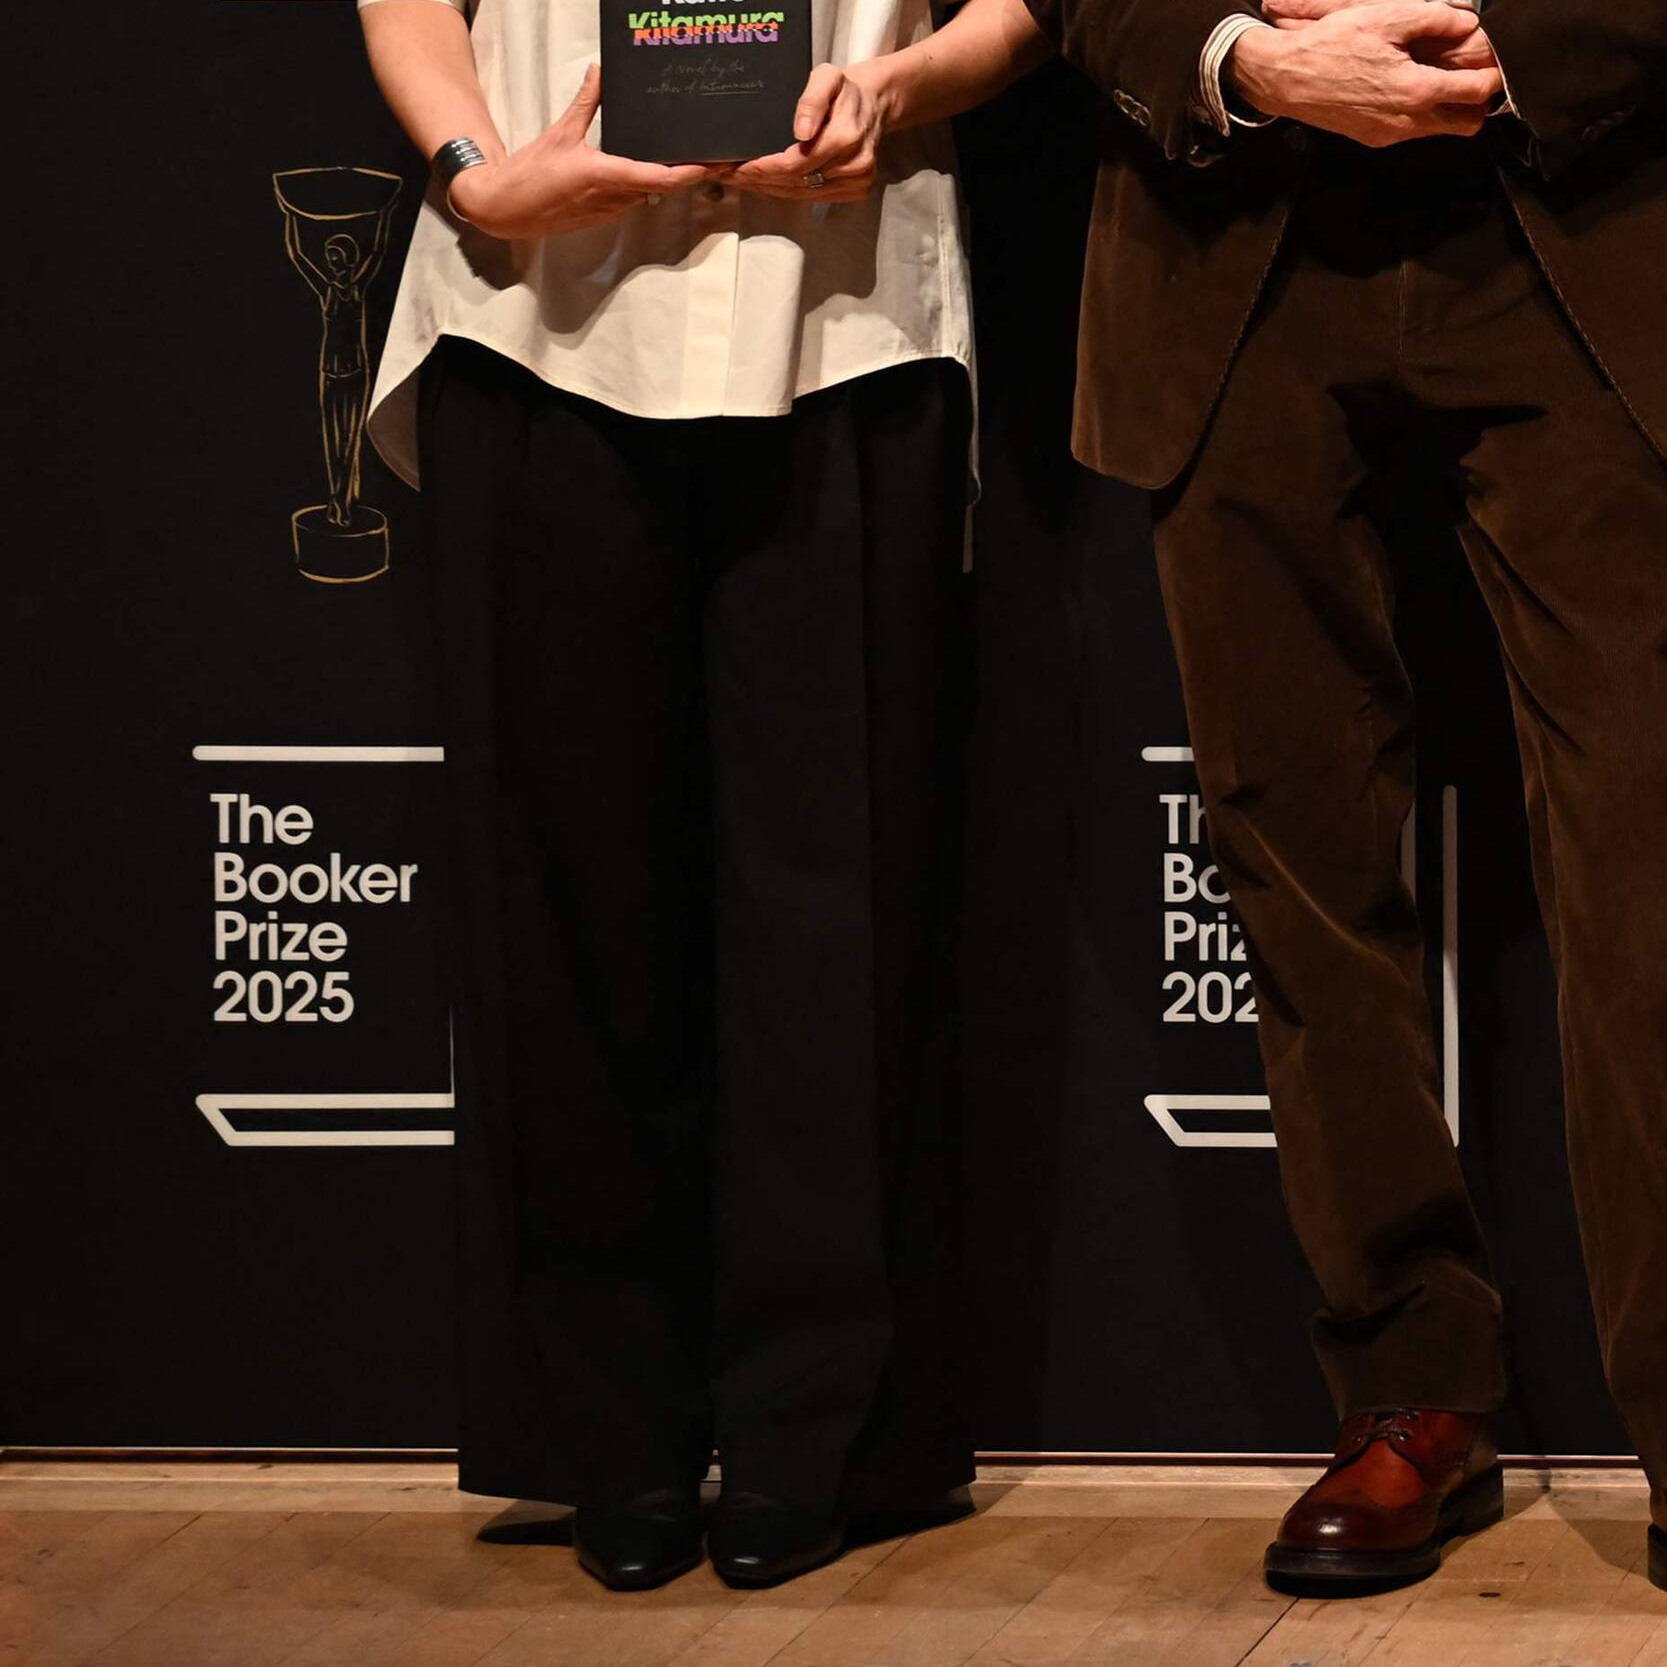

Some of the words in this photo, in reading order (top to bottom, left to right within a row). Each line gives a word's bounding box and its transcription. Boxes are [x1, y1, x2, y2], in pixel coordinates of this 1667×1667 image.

[628, 11, 784, 46] Kitamura
[211, 794, 313, 845] The
[1160, 795, 1207, 844] Th
[215, 853, 418, 903] Booker
[216, 911, 348, 962] Prize
[1164, 912, 1246, 961] Pri
[214, 971, 354, 1023] 2025
[1162, 972, 1259, 1023] 202
